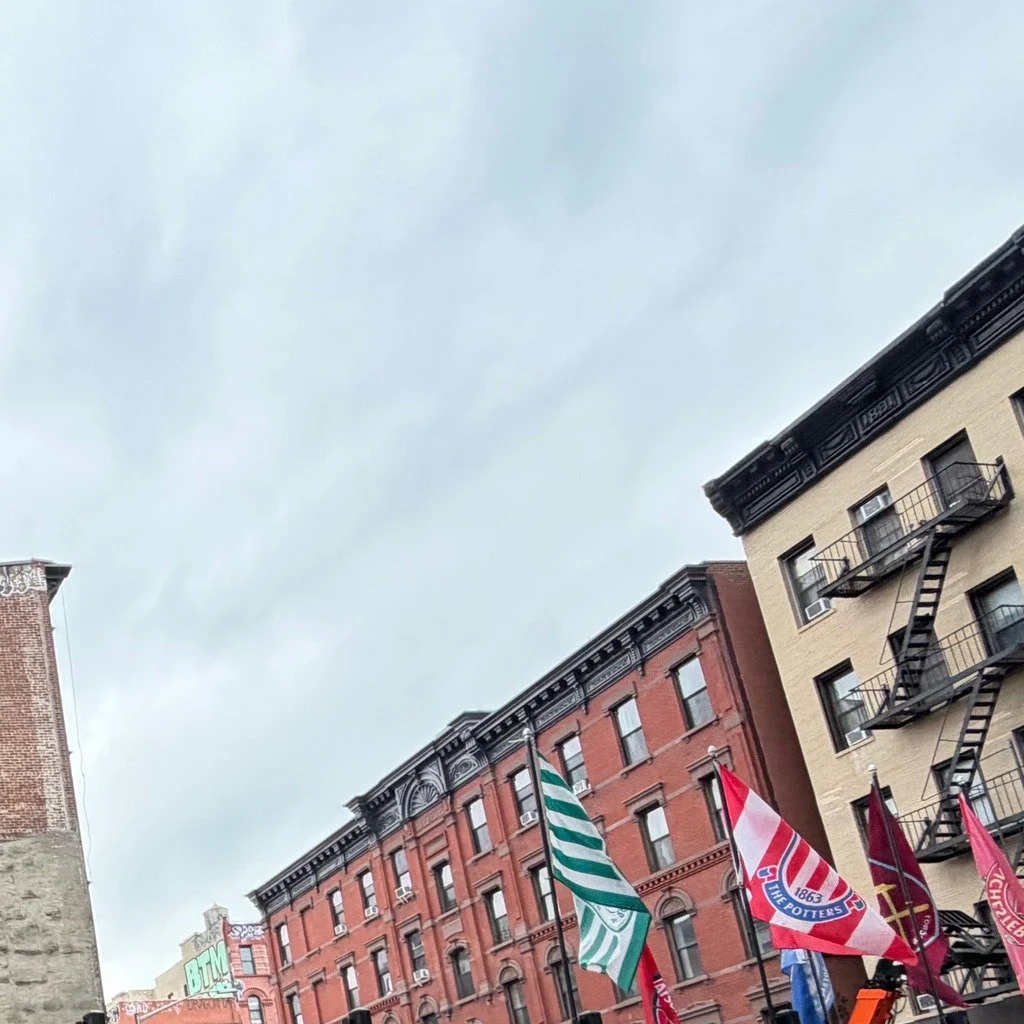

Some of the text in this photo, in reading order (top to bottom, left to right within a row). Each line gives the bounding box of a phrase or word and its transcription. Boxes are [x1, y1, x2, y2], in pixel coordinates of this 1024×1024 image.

[768, 883, 843, 919] THE POTTERS
[794, 887, 823, 904] 1863
[184, 939, 229, 996] BTM
